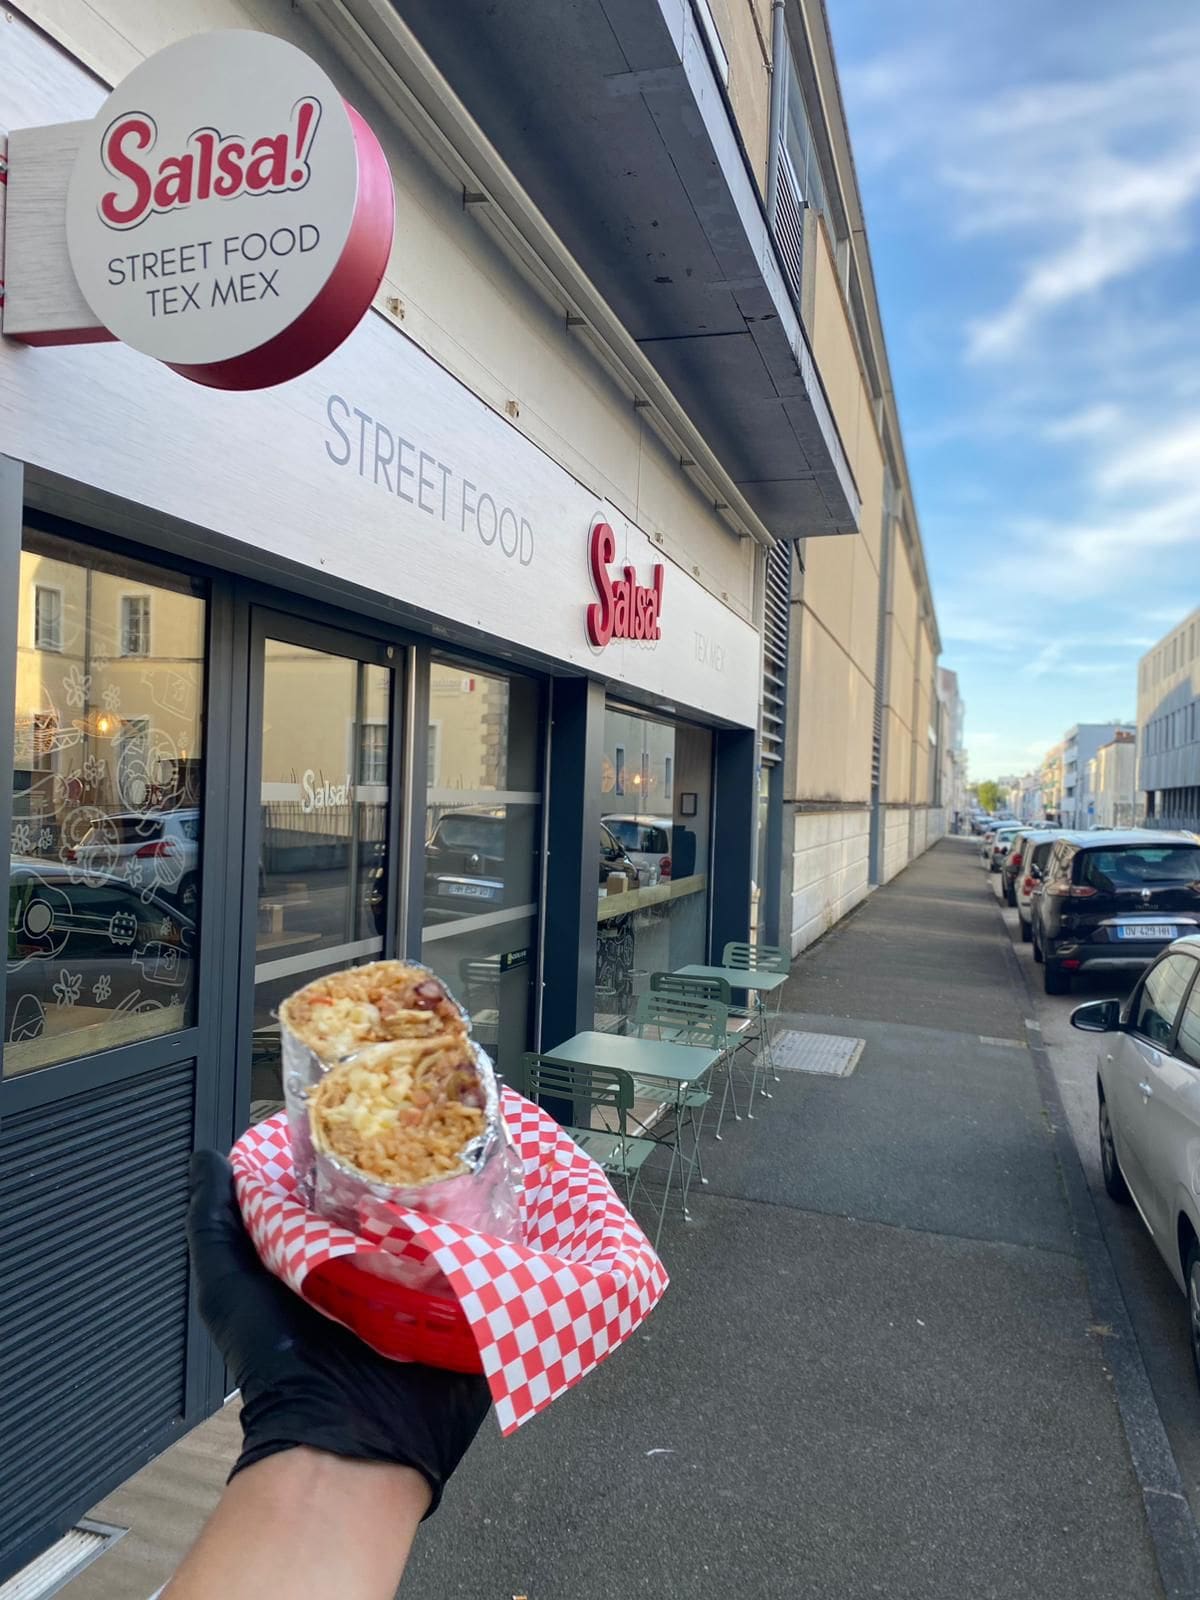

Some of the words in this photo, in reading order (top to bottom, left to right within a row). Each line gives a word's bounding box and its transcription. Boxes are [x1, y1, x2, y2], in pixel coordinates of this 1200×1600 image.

[99, 101, 316, 226] Salsa!
[107, 241, 212, 286] STREET
[224, 224, 320, 266] FOOD
[146, 282, 201, 317] TEX
[211, 269, 280, 307] MEX
[325, 394, 453, 522] STREET
[461, 478, 534, 567] FOOD
[586, 522, 665, 648] Salsa!
[694, 630, 709, 665] TEX
[710, 638, 728, 676] MEX
[301, 768, 352, 814] Salsa!
